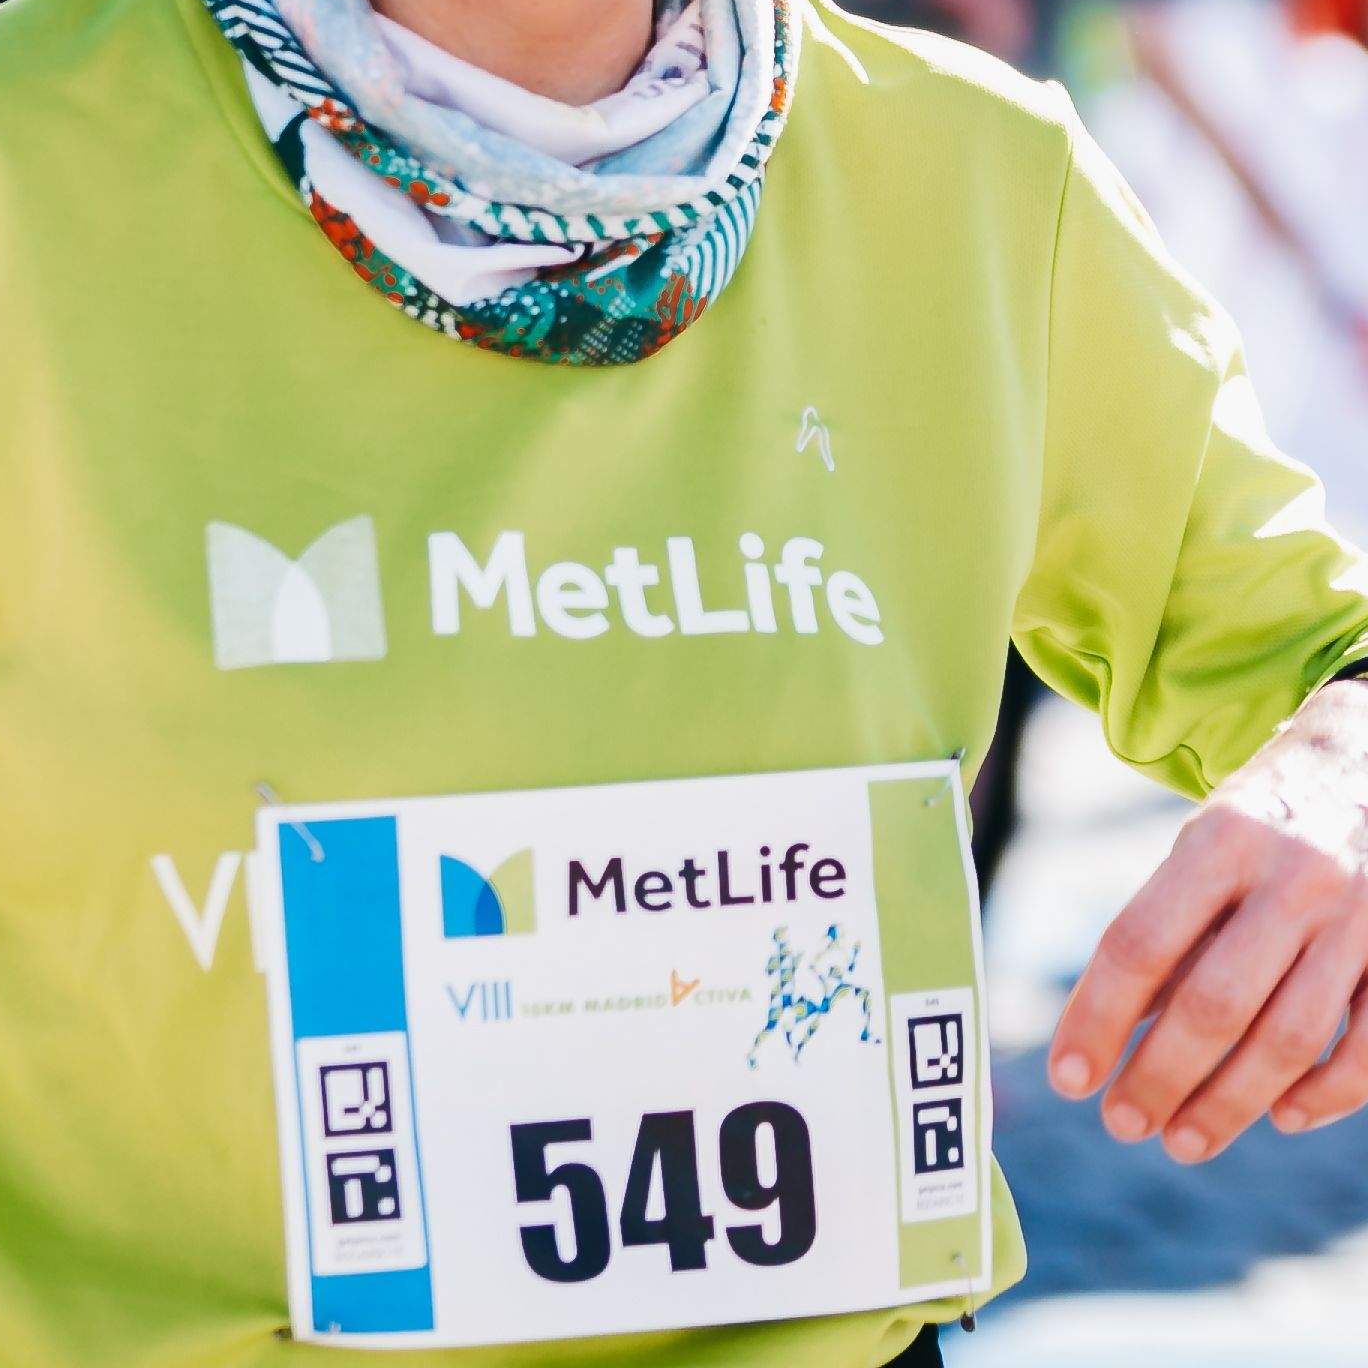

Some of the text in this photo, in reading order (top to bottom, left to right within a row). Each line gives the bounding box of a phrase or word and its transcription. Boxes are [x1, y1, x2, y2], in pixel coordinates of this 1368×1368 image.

[427, 530, 885, 645] MetLife
[568, 843, 848, 917] MetLife
[446, 980, 513, 1021] VIII
[509, 1100, 818, 1284] 549
